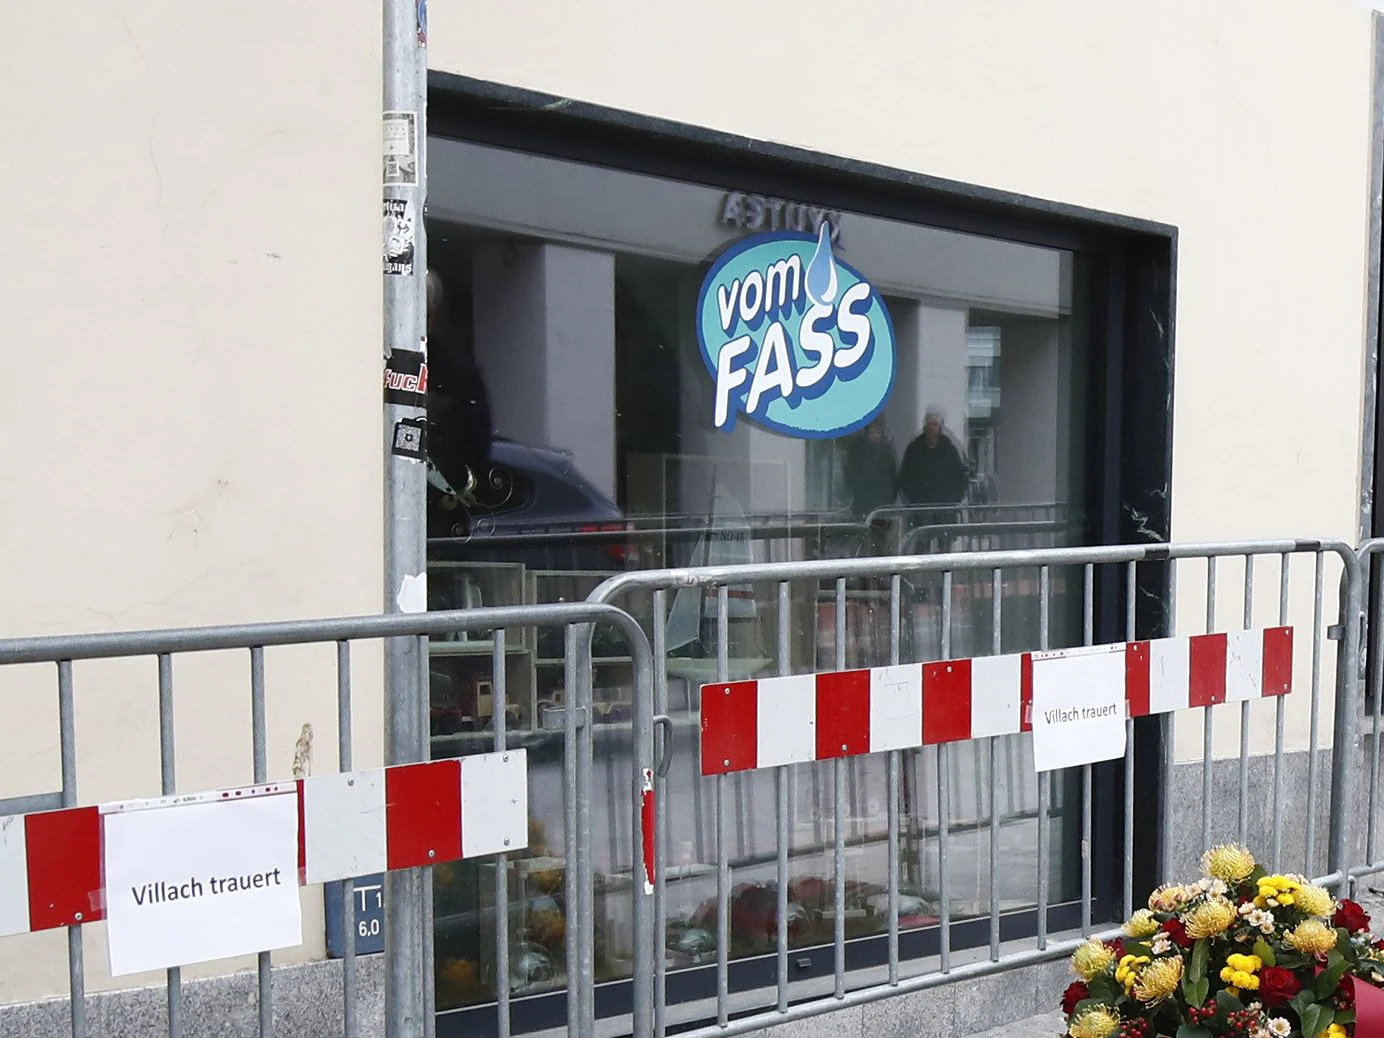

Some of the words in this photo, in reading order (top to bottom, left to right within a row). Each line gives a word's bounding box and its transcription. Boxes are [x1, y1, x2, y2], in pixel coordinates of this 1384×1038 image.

[717, 253, 802, 331] vom
[714, 282, 872, 428] FASS
[1044, 706, 1080, 725] Villach
[1082, 702, 1117, 719] trauert
[131, 876, 204, 906] Villach
[209, 866, 282, 895] trauert
